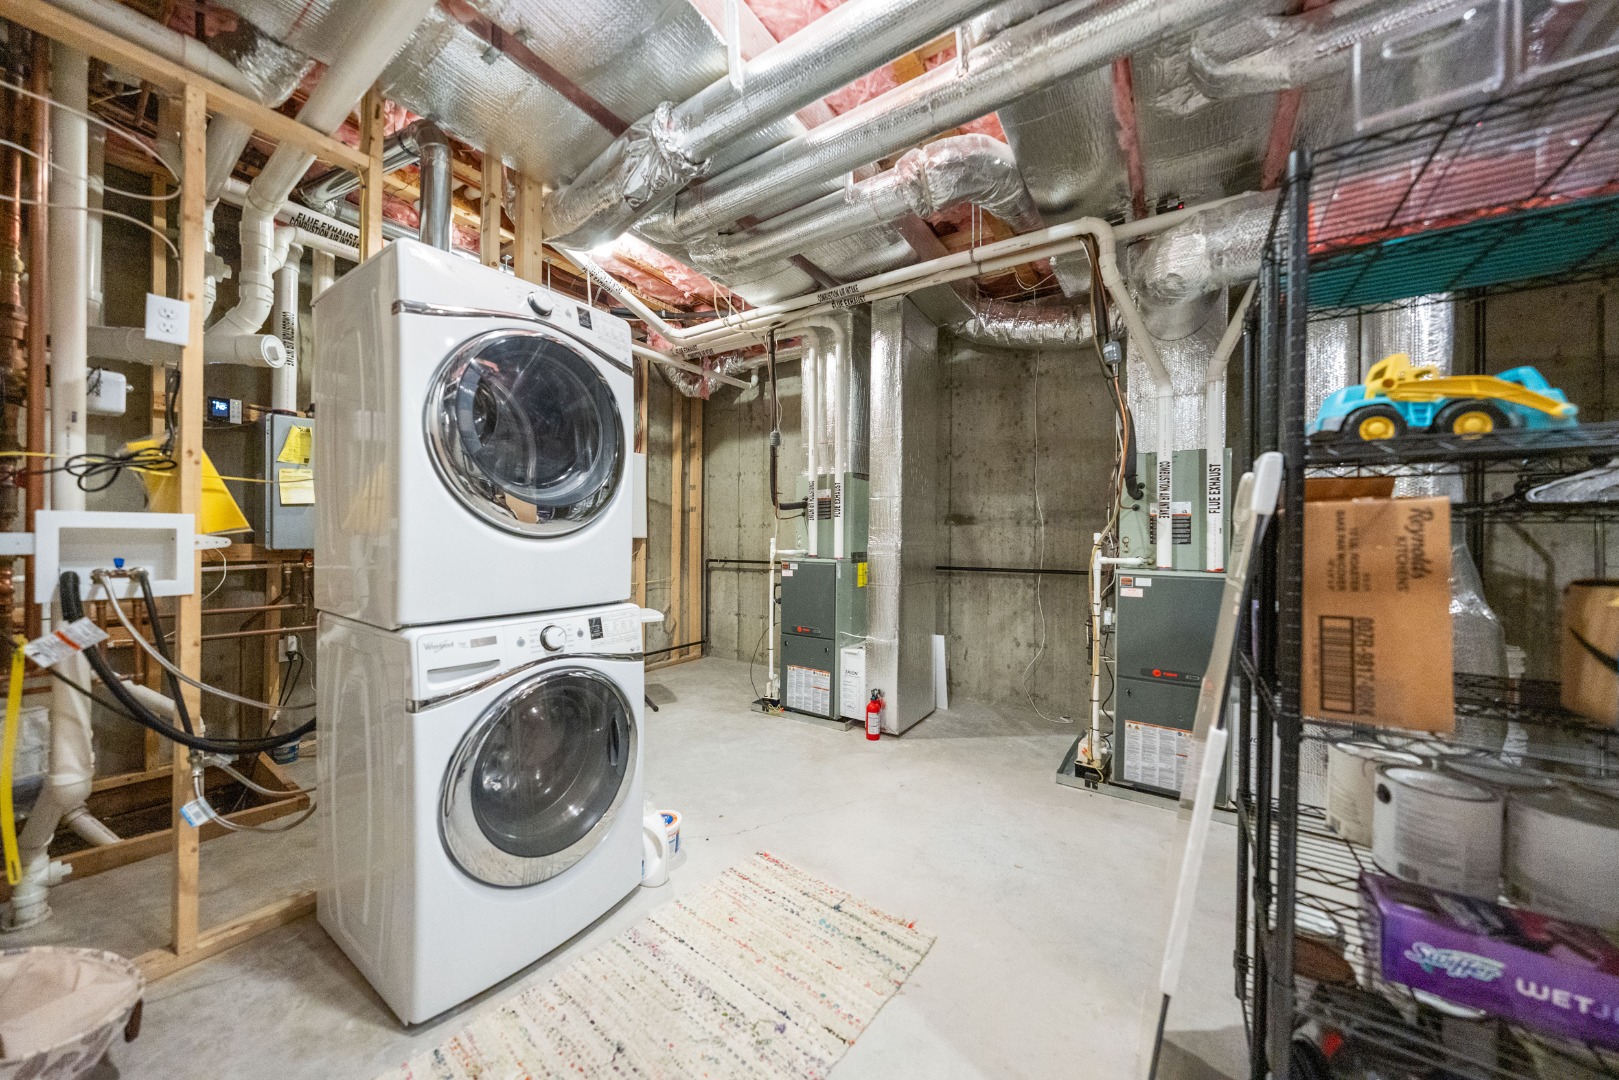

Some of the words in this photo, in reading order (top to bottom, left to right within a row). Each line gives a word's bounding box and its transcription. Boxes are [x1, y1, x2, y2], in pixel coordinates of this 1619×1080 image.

[1209, 464, 1220, 495] EXHAUST
[1209, 497, 1220, 514] FLUE
[1404, 506, 1435, 580] Reynolds
[424, 640, 454, 653] Whirlpool
